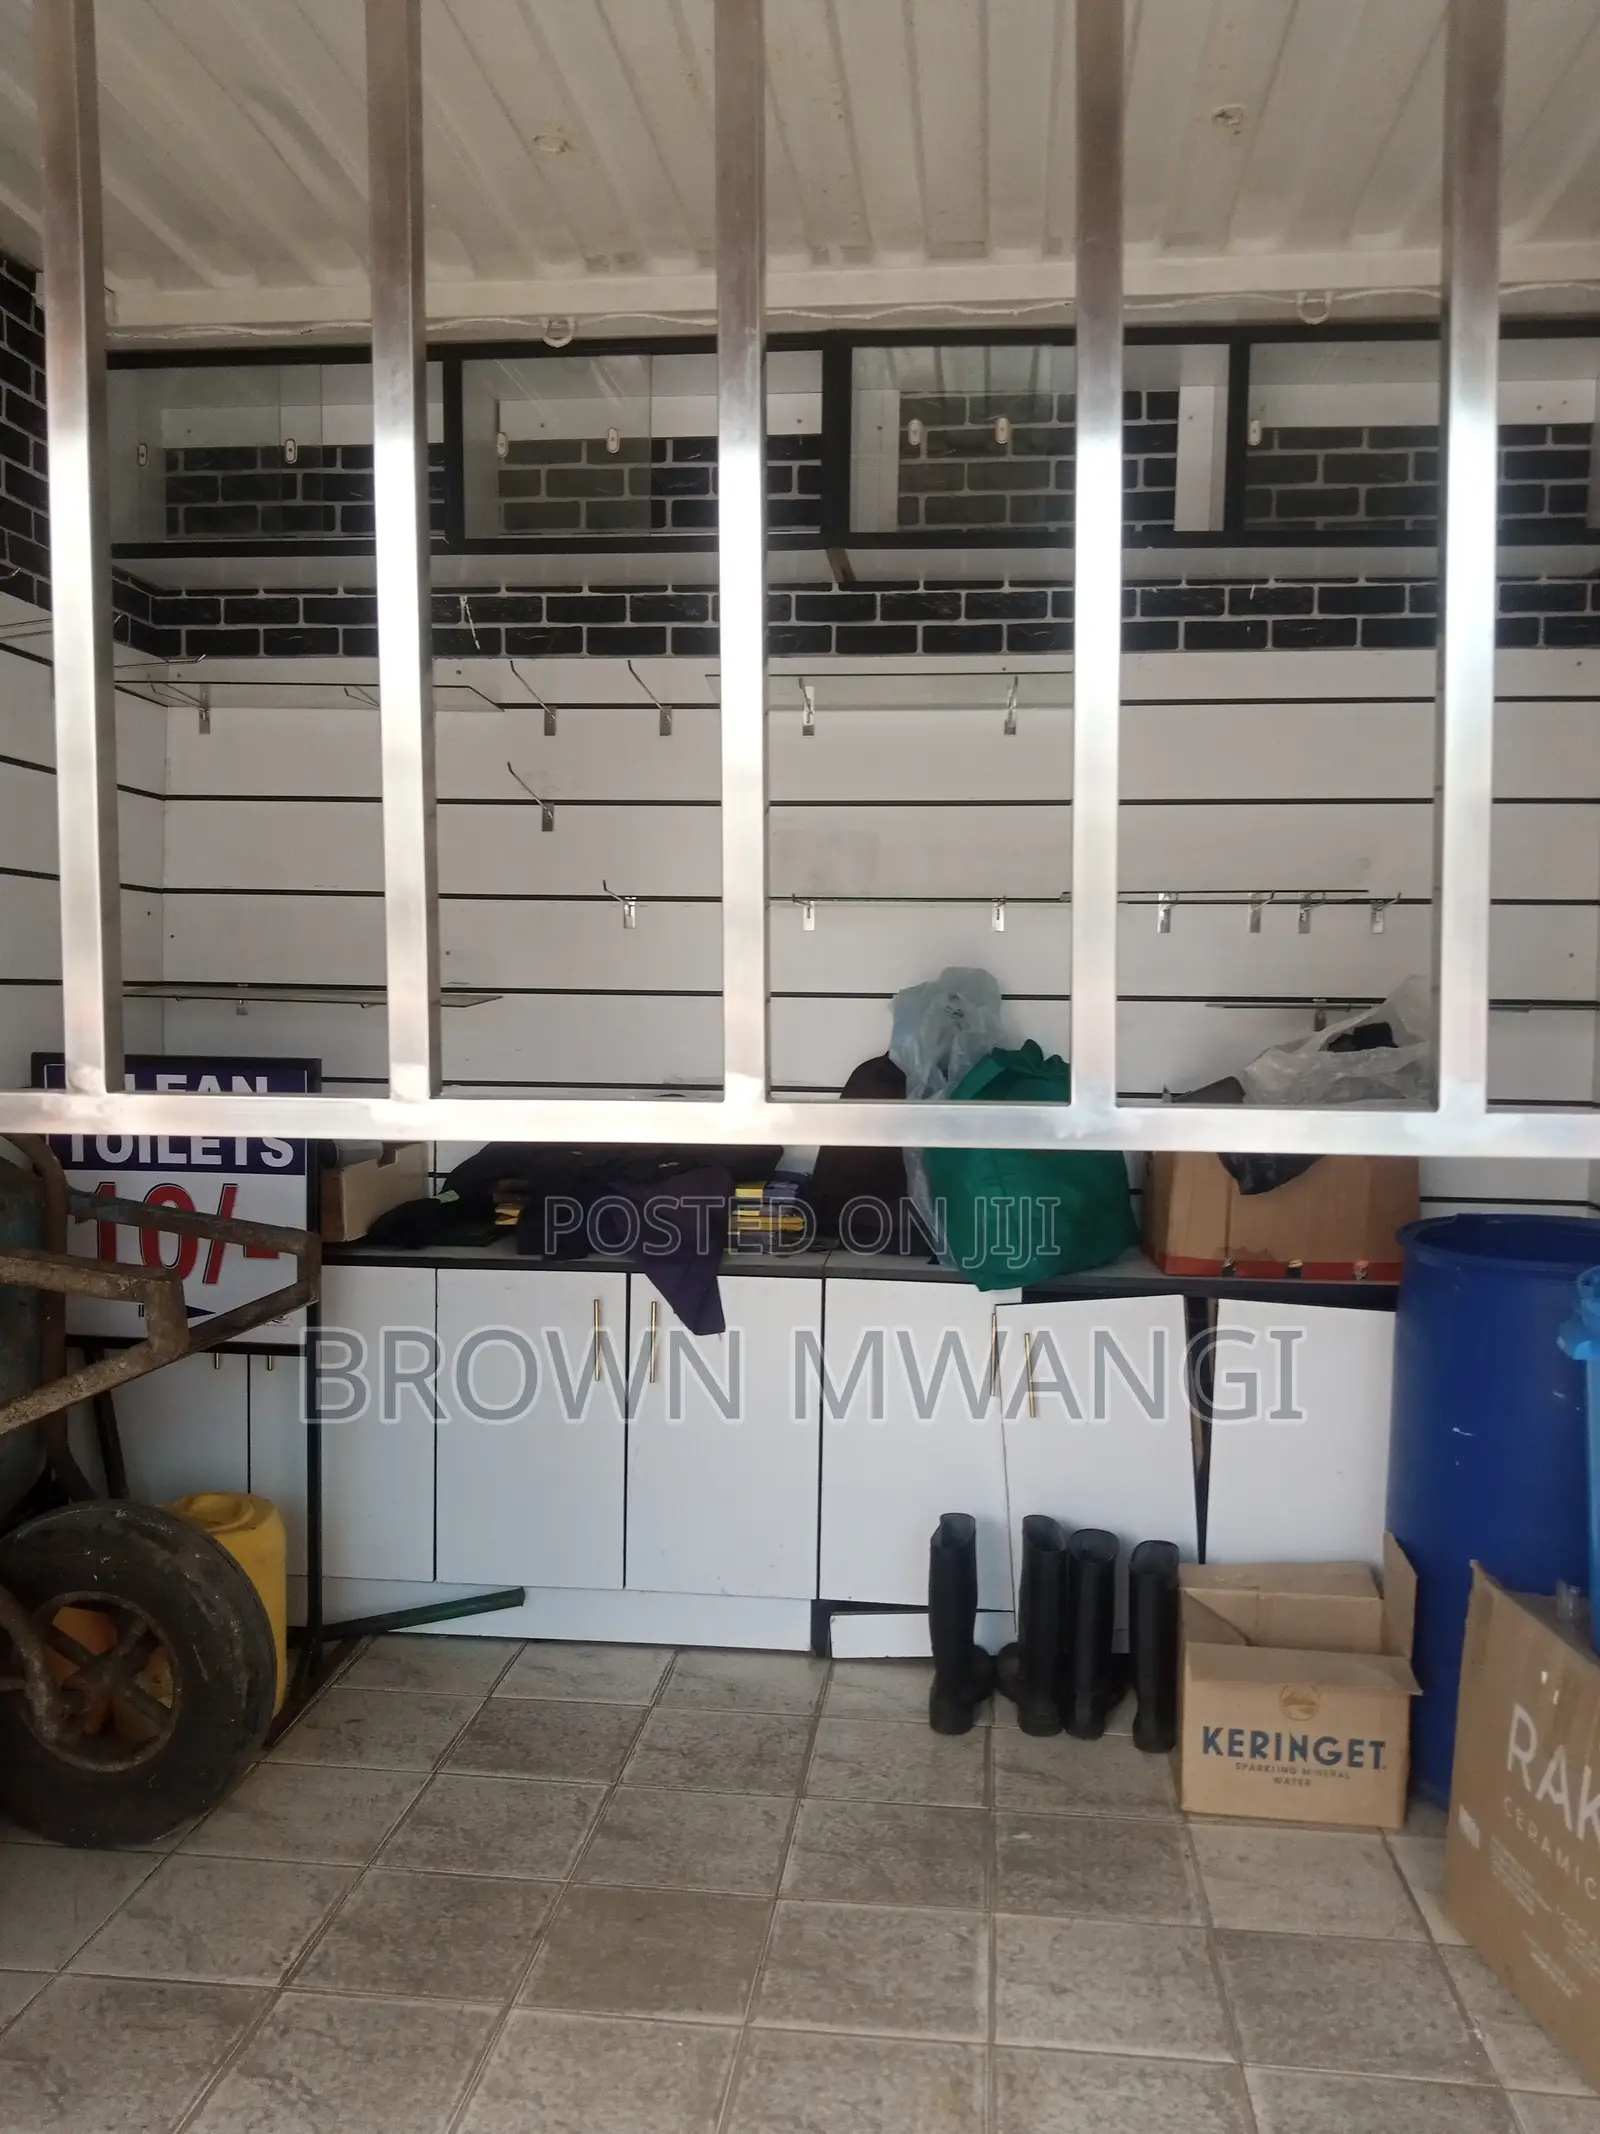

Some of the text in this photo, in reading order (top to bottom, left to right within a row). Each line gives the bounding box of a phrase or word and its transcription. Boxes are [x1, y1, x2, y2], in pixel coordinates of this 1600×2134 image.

[71, 1134, 294, 1168] TOILETS
[1202, 1725, 1386, 1770] KERINGET
[1235, 1762, 1298, 1776] SPARKLING
[1273, 1776, 1312, 1787] WATER
[1507, 1702, 1600, 1841] RAK
